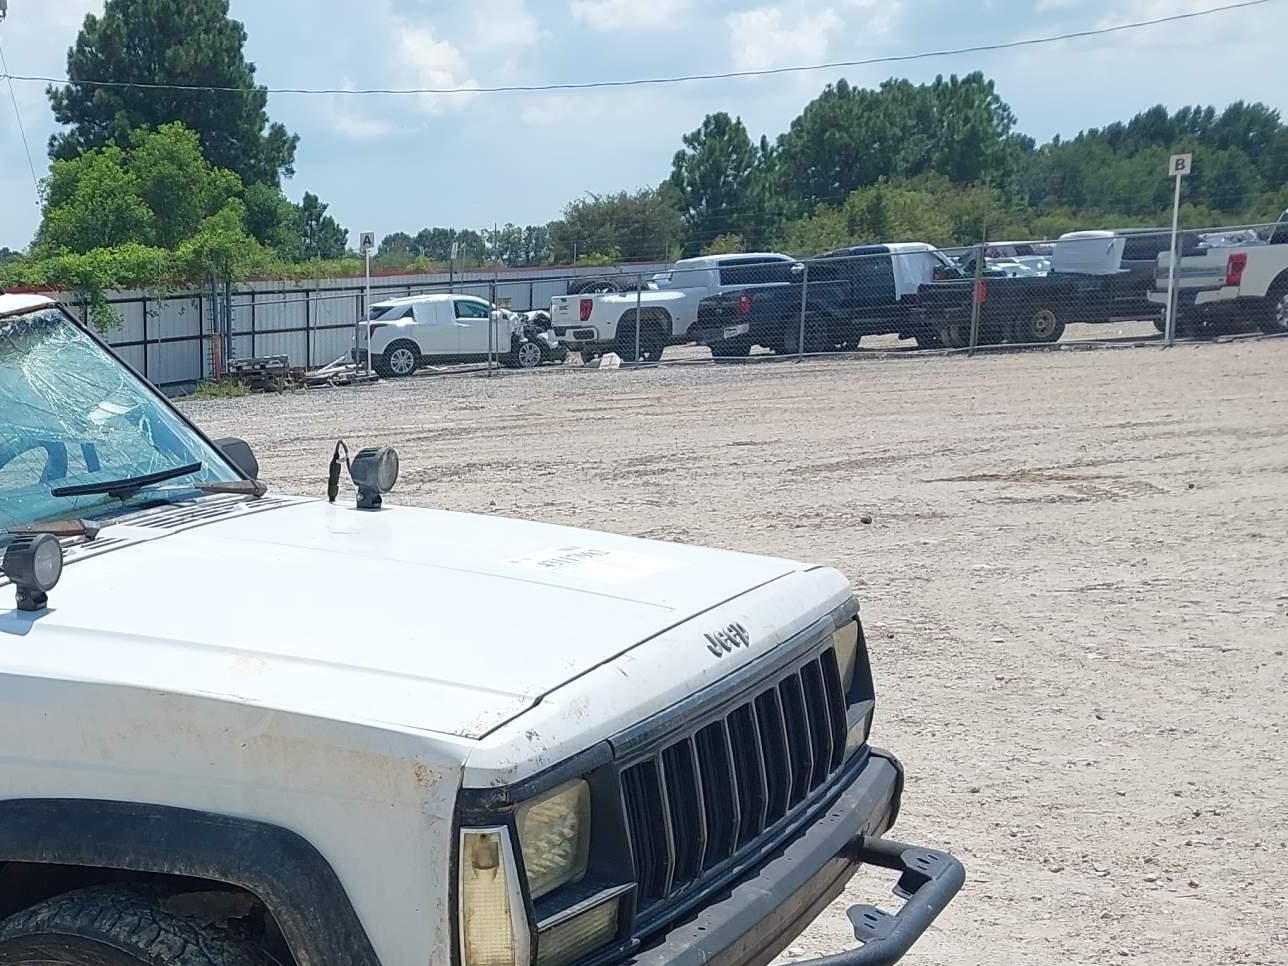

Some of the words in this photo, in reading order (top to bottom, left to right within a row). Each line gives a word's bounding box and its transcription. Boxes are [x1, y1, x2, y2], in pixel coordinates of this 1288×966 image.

[1175, 158, 1186, 171] B
[362, 235, 372, 246] A
[703, 621, 750, 659] Jeep
